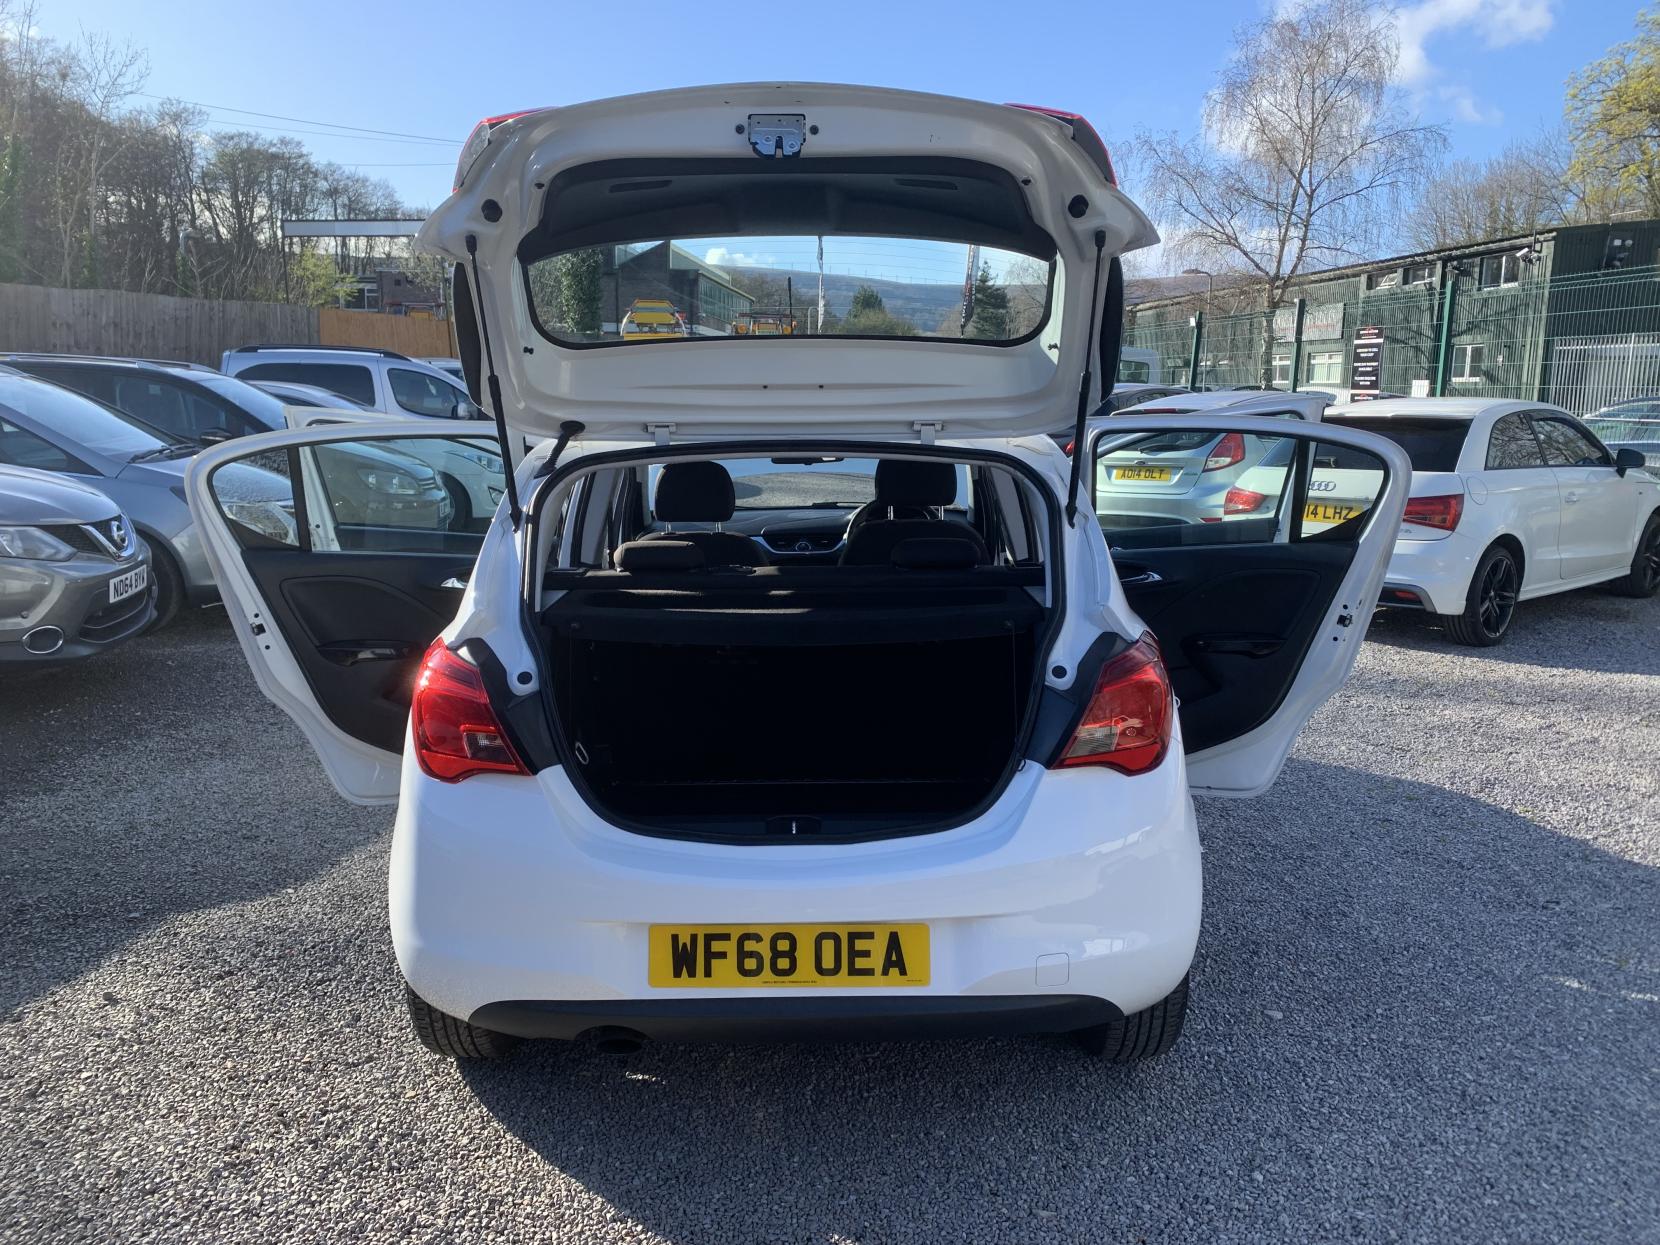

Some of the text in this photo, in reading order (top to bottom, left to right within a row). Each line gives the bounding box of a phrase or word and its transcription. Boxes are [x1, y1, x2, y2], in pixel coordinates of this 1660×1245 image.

[1306, 504, 1353, 520] 14 LHZ
[113, 574, 133, 600] ND64
[671, 931, 908, 979] WF68 OEA
